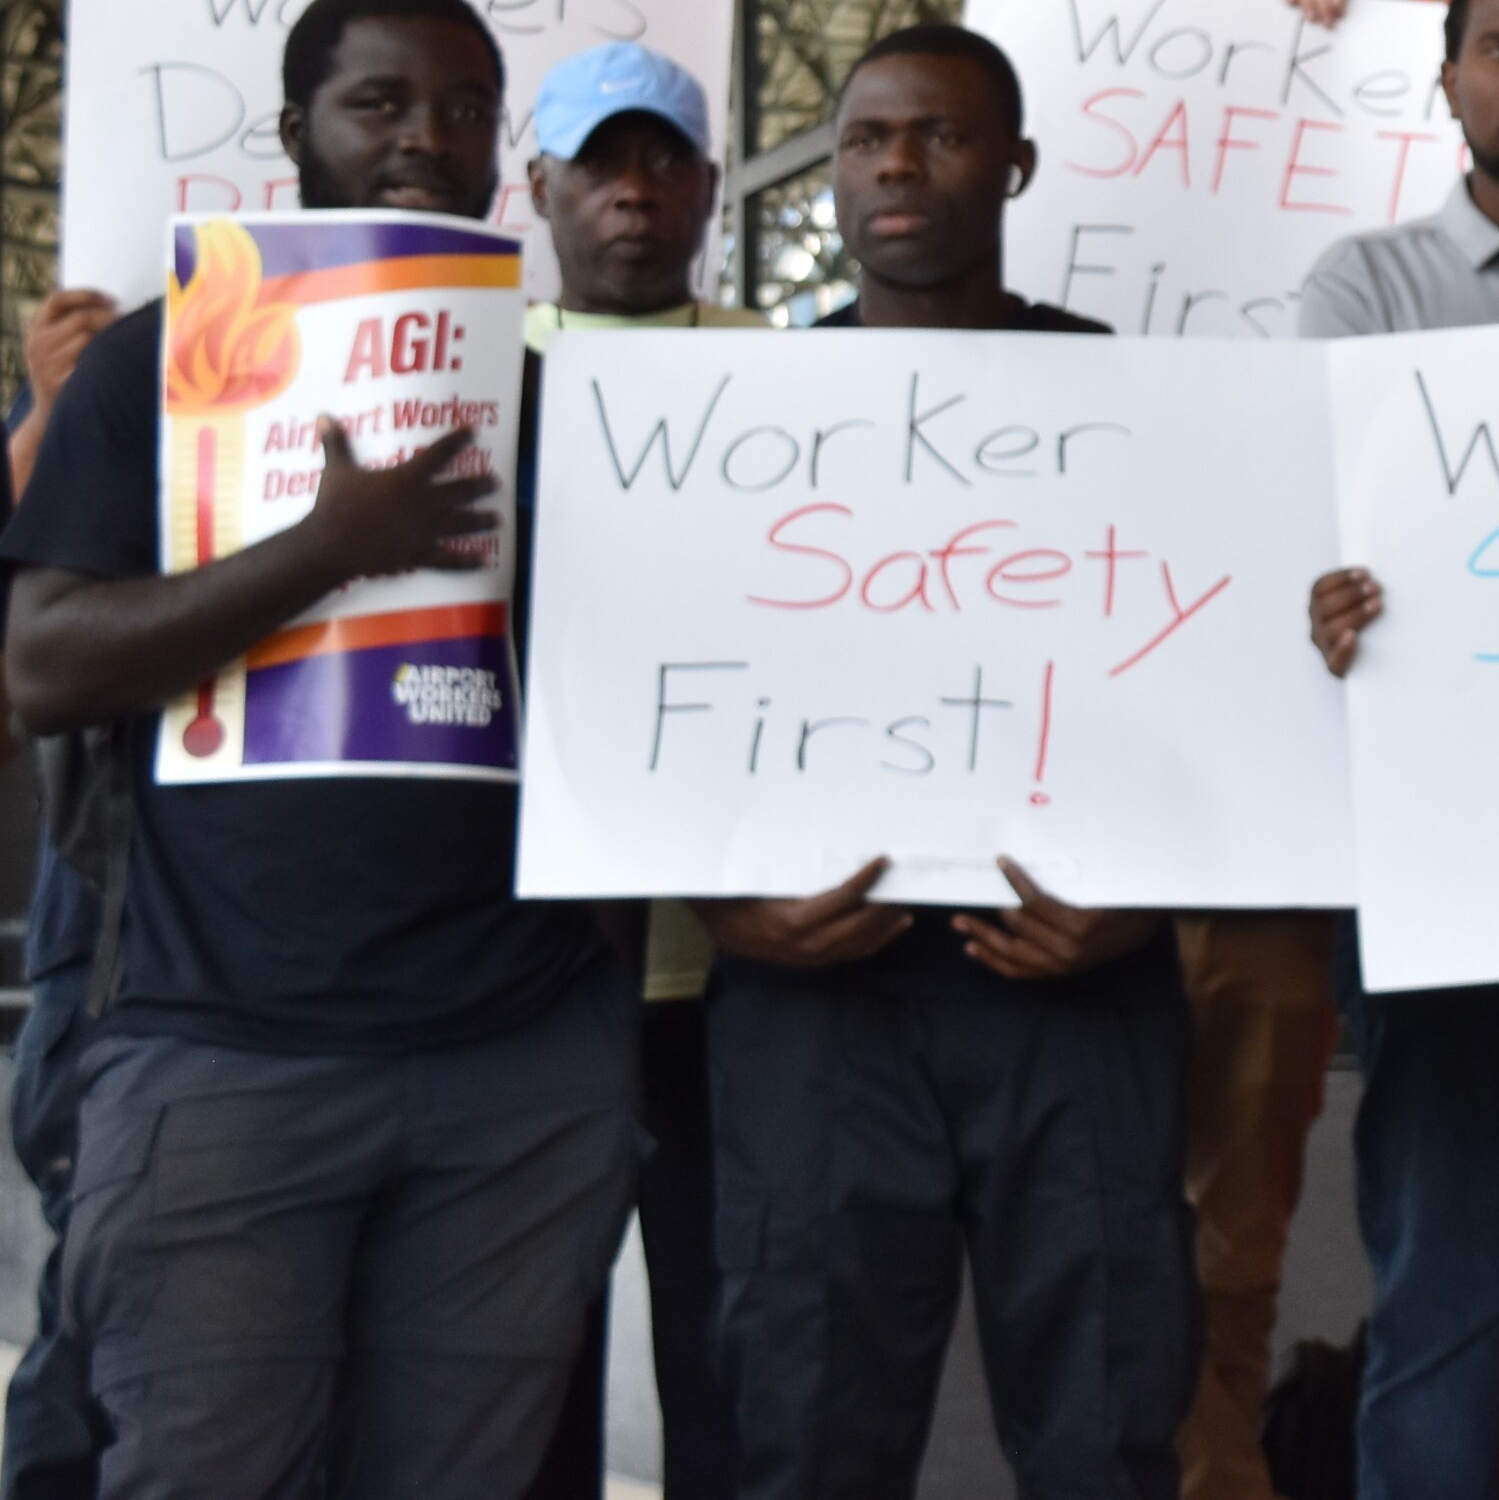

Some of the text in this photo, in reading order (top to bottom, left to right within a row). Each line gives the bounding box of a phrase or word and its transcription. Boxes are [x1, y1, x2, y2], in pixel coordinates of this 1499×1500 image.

[1063, 86, 1468, 224] SAFET
[342, 310, 465, 384] AGI:
[590, 371, 1132, 492] Worker
[747, 502, 1232, 678] Safety
[408, 702, 491, 726] UNITED
[650, 660, 1053, 808] First!
